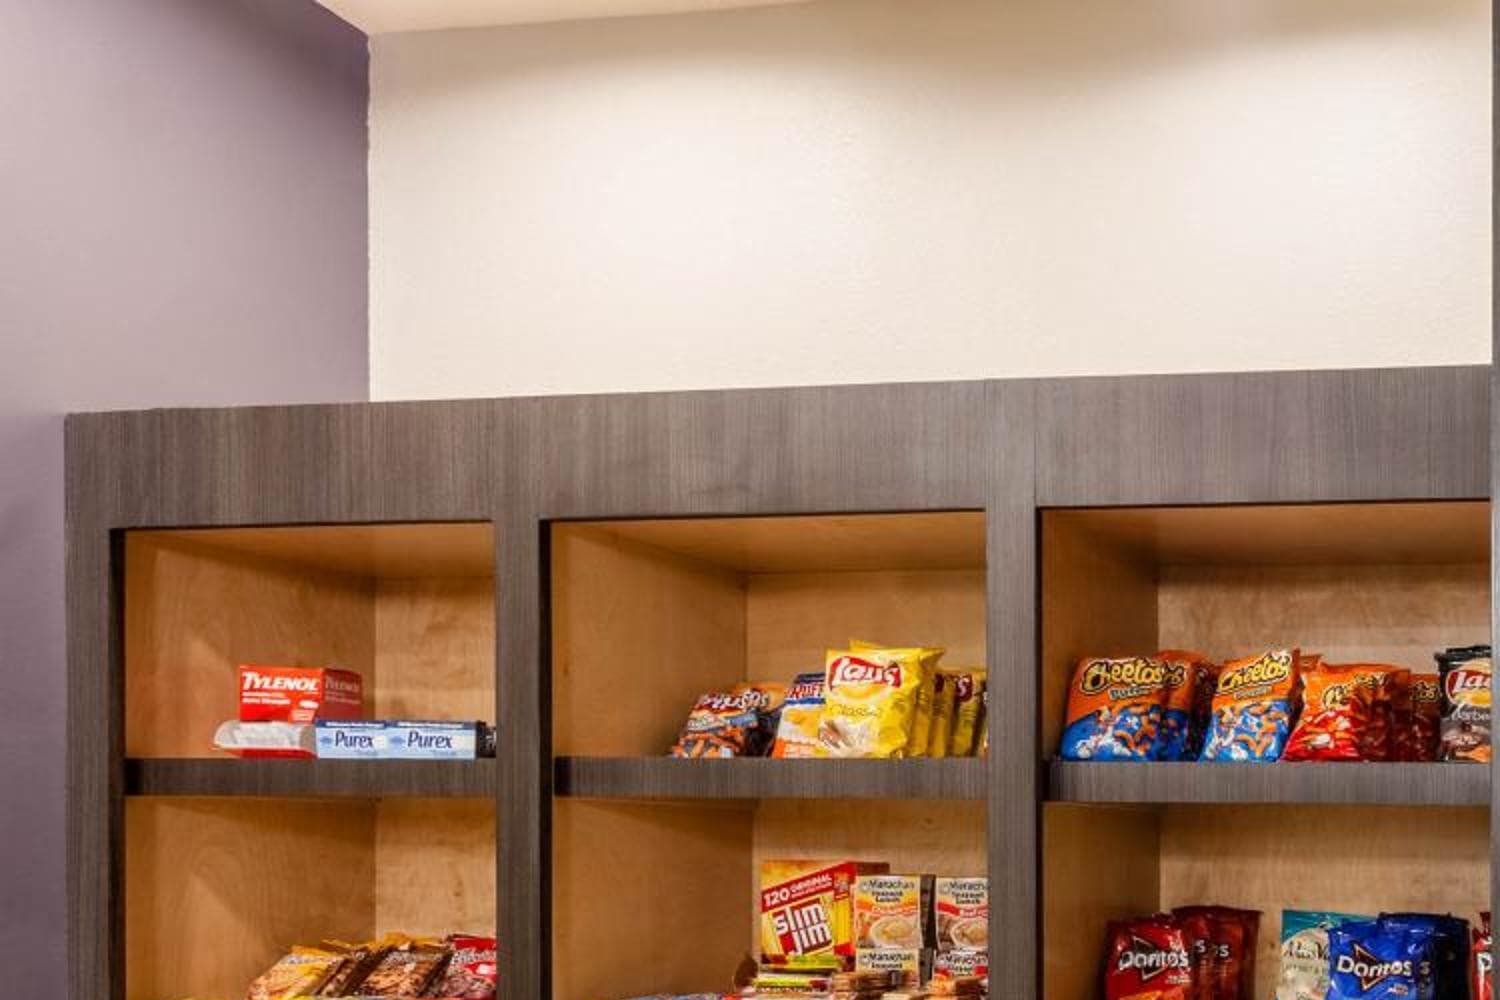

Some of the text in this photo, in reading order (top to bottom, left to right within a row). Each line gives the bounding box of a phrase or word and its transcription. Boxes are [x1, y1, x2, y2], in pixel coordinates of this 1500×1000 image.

[241, 671, 320, 691] TYLENOL
[1082, 657, 1163, 692] Cheetos
[335, 730, 374, 748] Purex
[406, 730, 454, 749] Purex
[869, 879, 916, 890] Maruchan
[763, 888, 790, 907] 120
[1119, 950, 1189, 971] Doritos
[1337, 956, 1413, 977] Doritos
